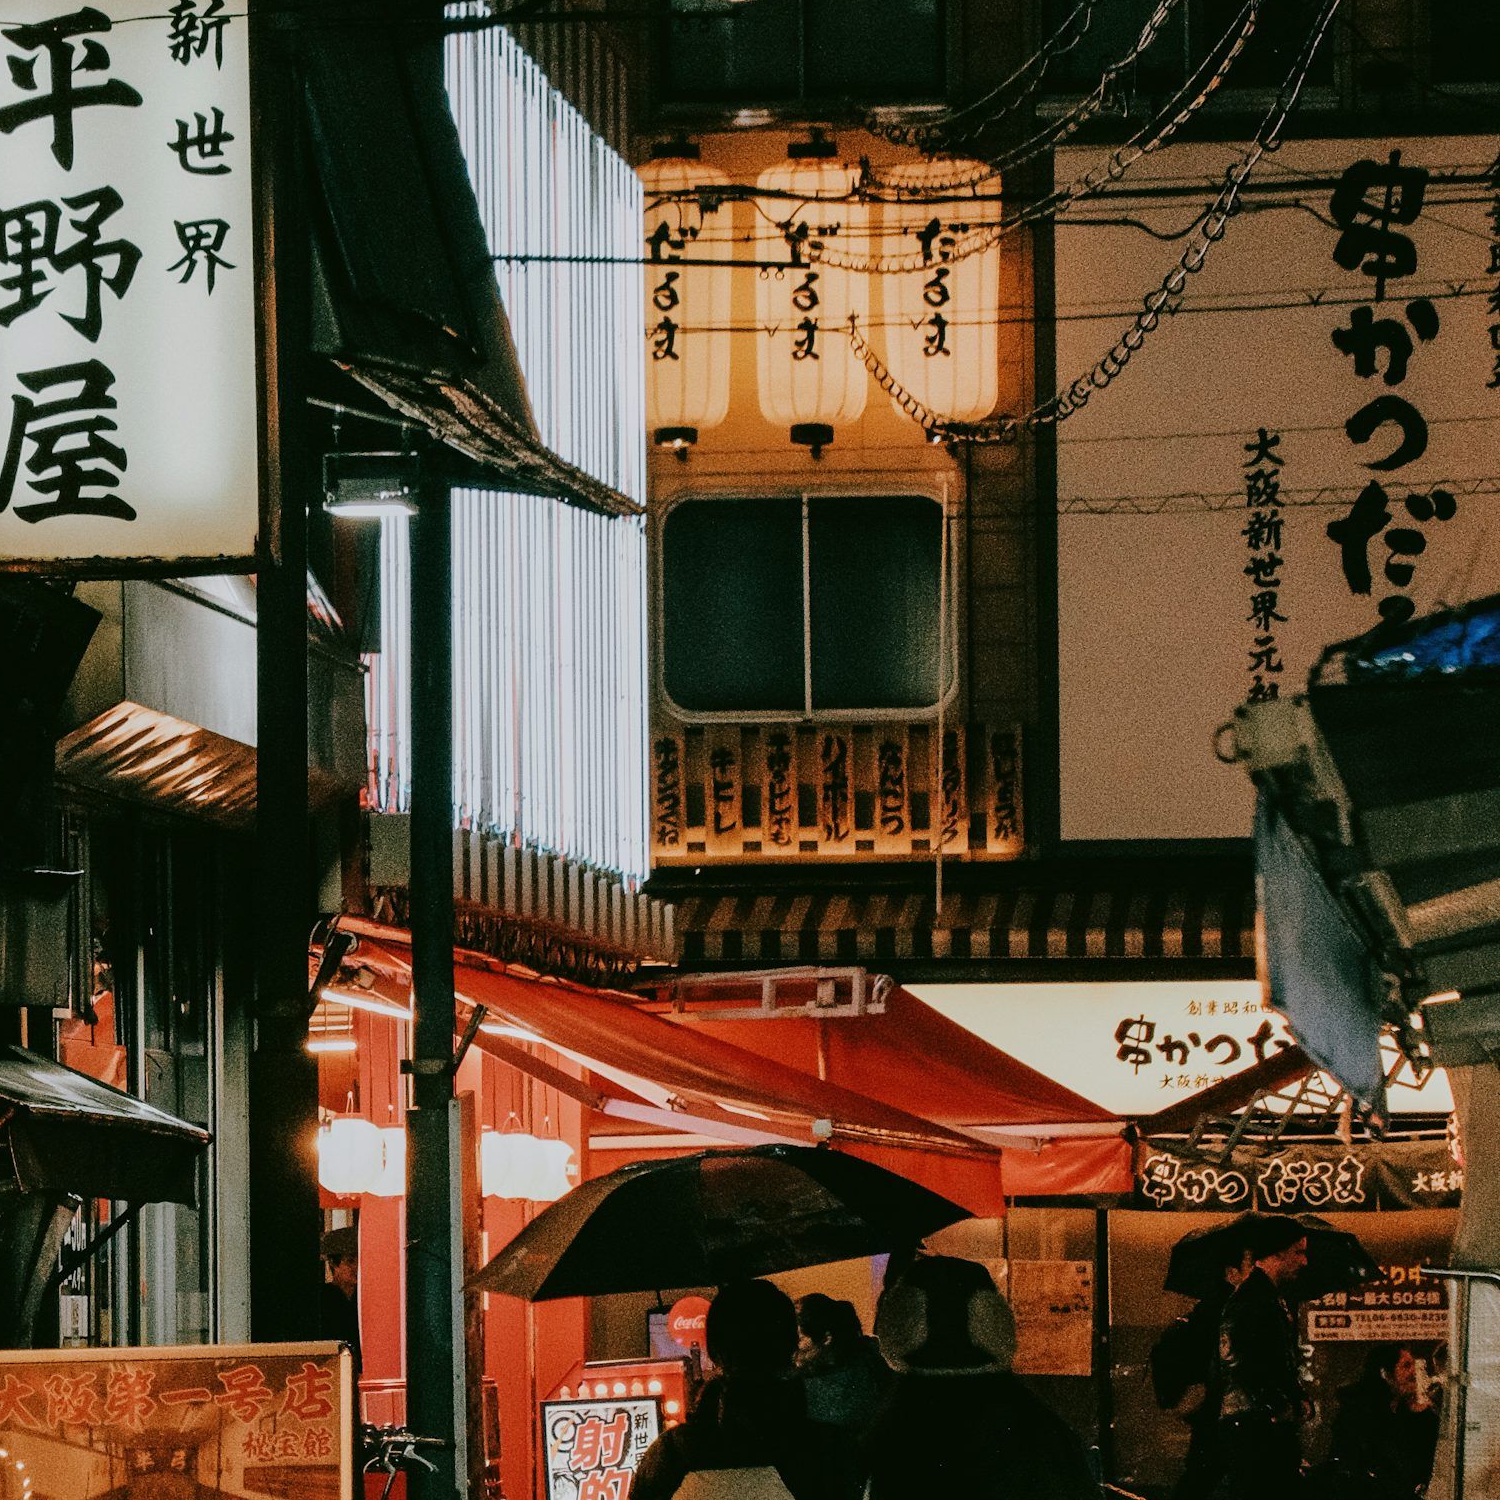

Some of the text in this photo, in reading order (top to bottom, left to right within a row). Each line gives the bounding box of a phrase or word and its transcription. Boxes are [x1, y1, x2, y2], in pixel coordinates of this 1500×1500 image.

[917, 217, 969, 357] だるま
[1327, 148, 1457, 630] 串かつだ
[673, 1314, 707, 1331] Coca-Co
